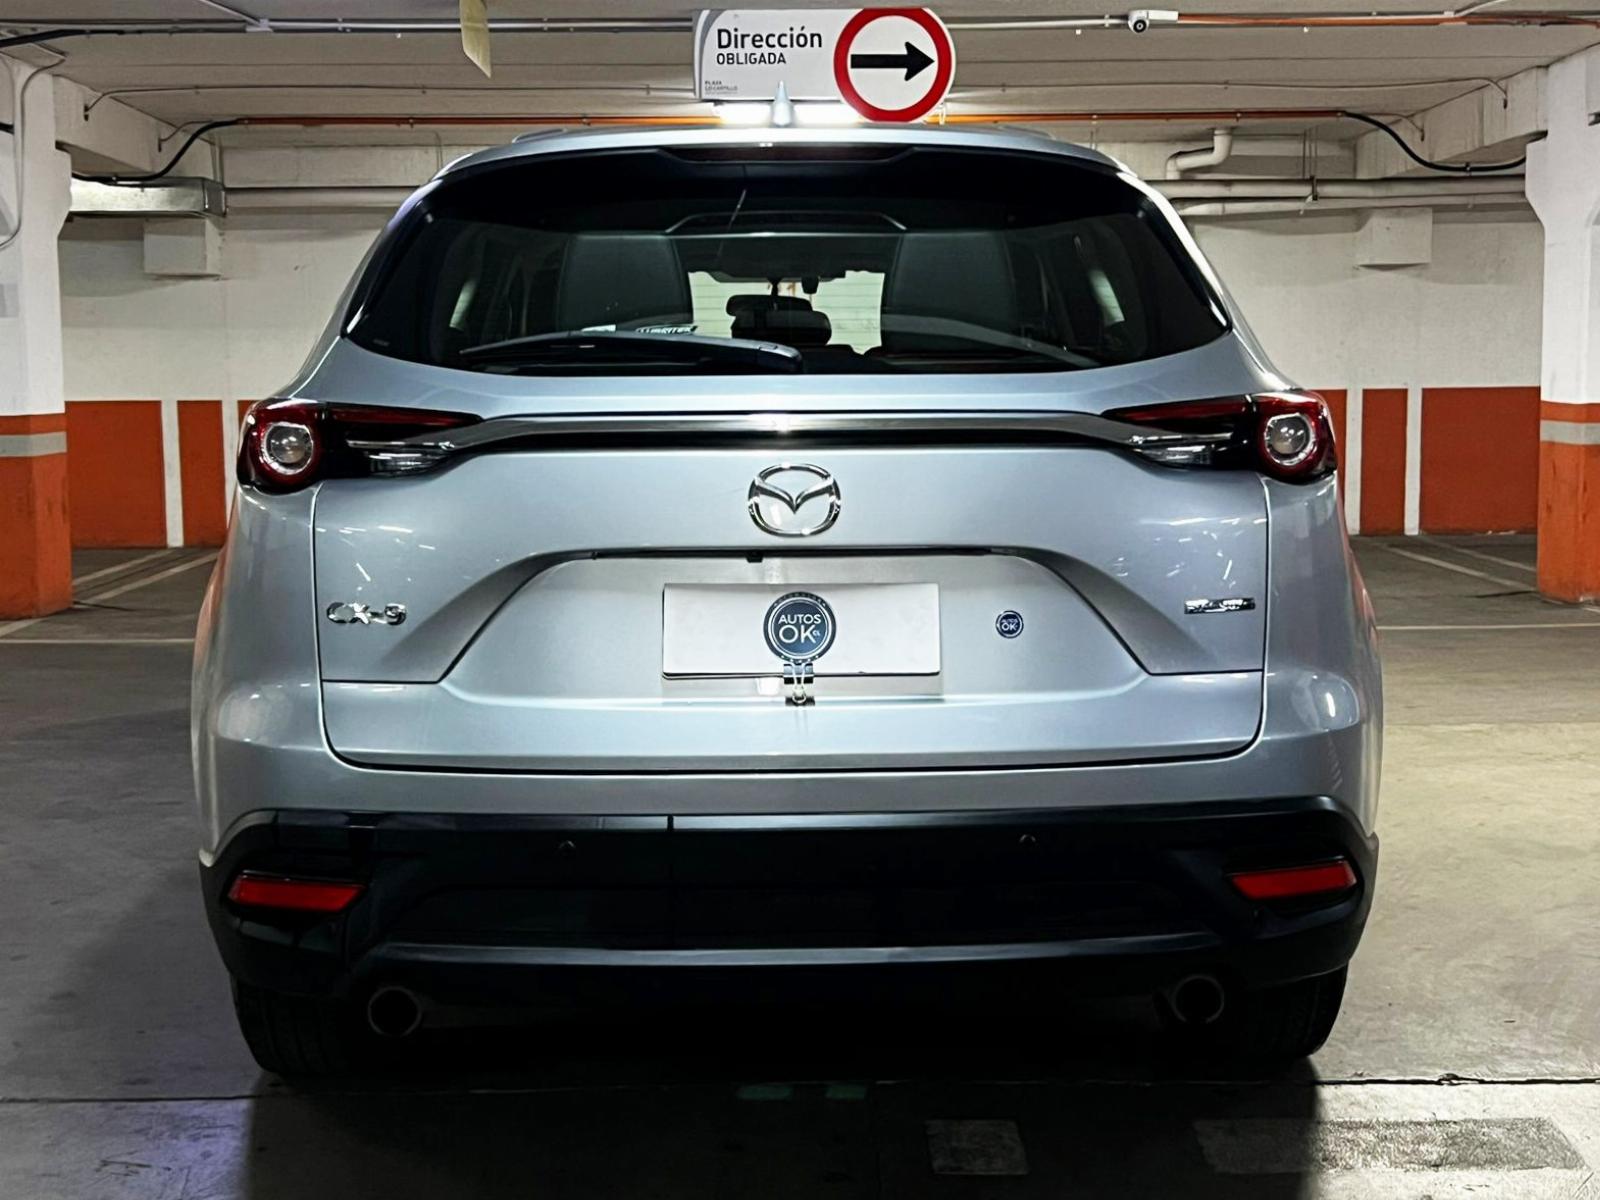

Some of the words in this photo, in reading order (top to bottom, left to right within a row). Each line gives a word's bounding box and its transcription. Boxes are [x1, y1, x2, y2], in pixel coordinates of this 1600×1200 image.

[717, 25, 822, 49] Dirección
[716, 52, 787, 65] OBLIGADA
[778, 614, 821, 624] AUTOS
[1001, 622, 1017, 631] OK
[779, 624, 816, 643] OK
